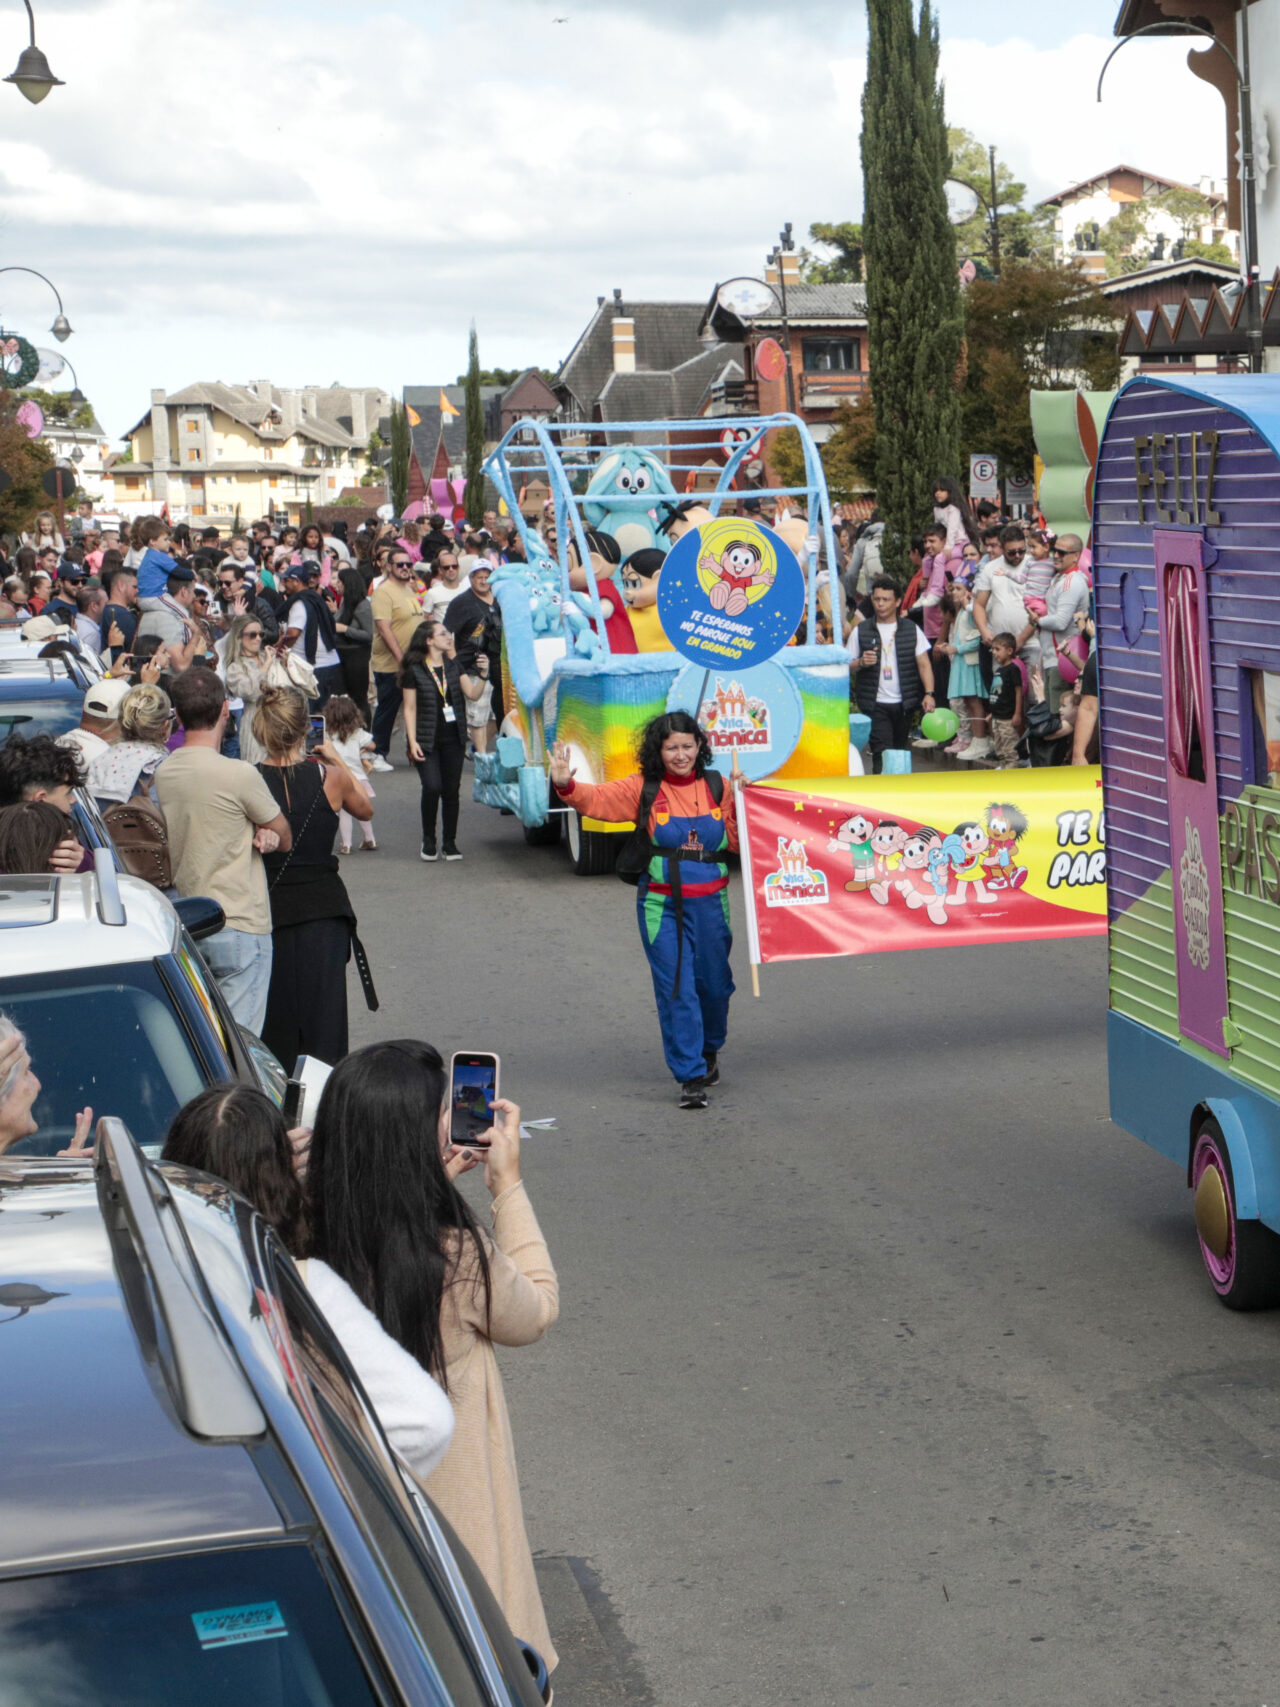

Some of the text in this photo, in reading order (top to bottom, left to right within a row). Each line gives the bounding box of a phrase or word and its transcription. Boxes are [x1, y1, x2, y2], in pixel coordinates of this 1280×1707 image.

[980, 464, 988, 477] E
[1133, 429, 1221, 526] FELIZ
[680, 621, 695, 632] NO
[695, 624, 733, 645] PARQUE
[690, 611, 754, 637] TE ESPERAMOS
[686, 635, 743, 660] EM GRAMADO
[719, 718, 744, 729] Vila
[1057, 809, 1092, 847] TE
